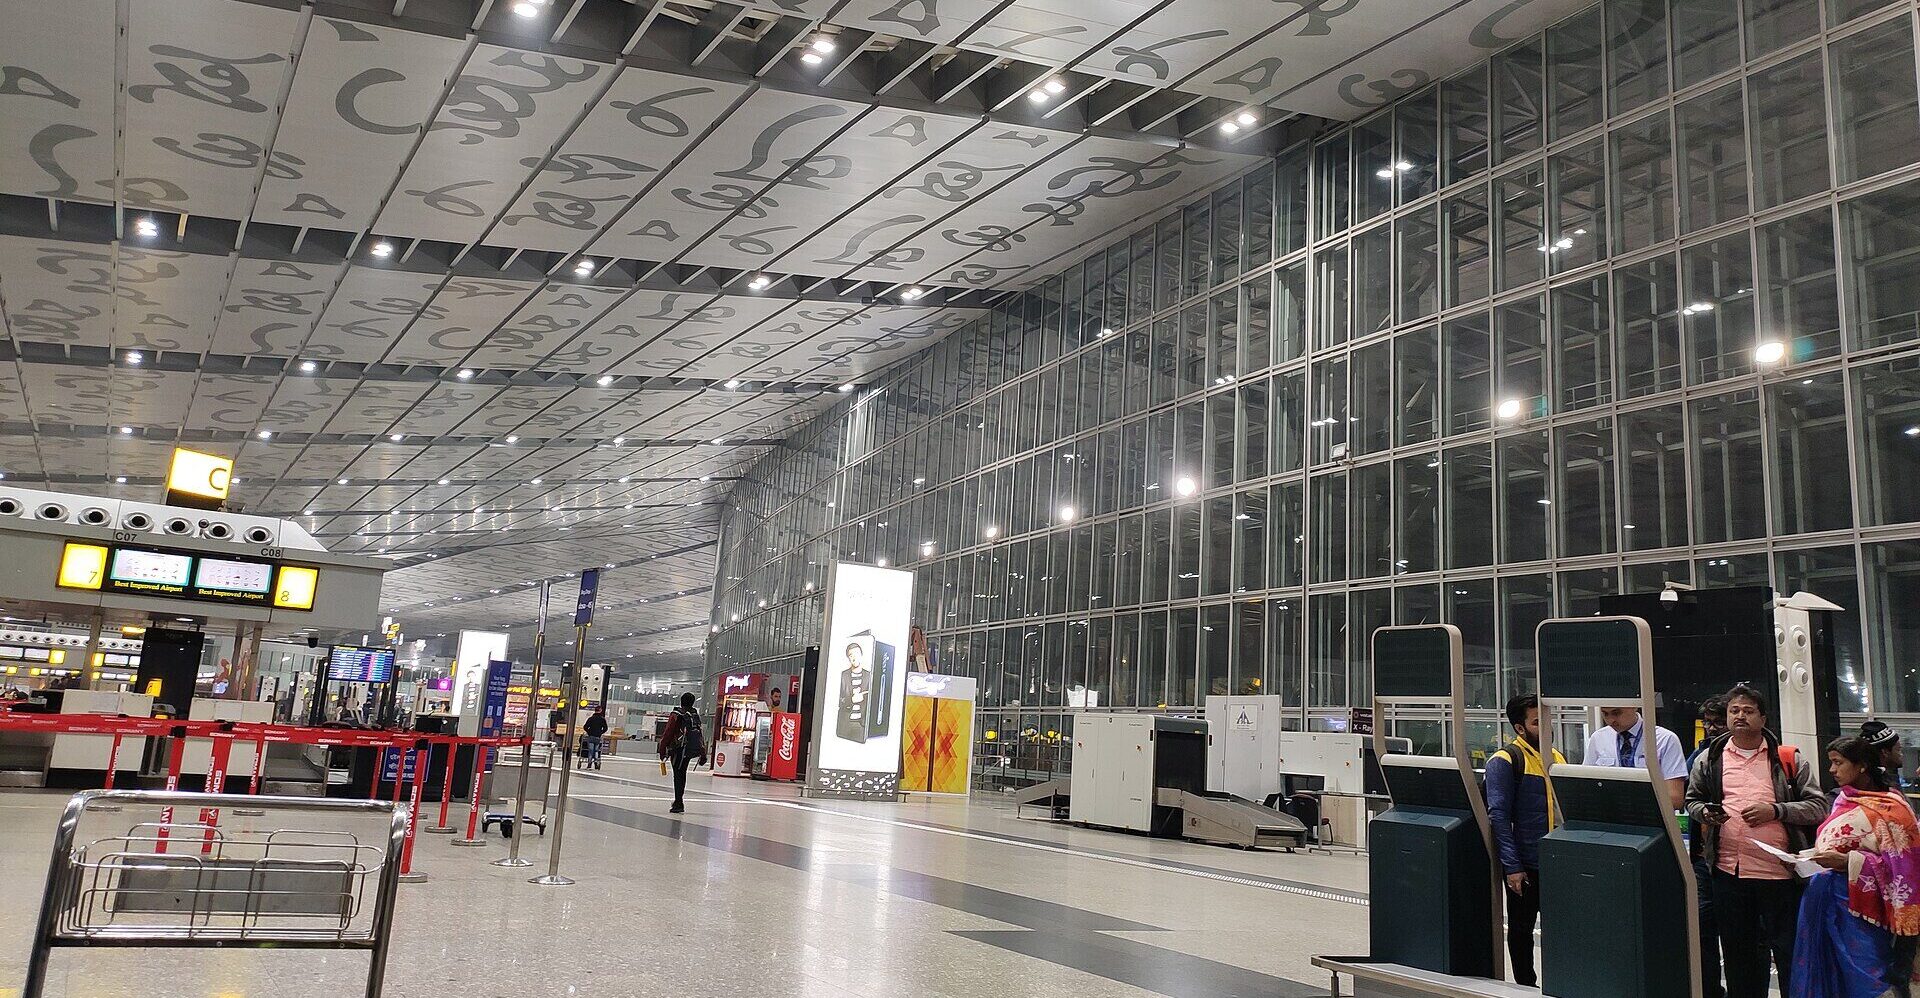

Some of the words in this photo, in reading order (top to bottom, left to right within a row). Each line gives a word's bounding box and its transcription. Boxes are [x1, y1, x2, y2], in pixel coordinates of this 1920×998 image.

[209, 468, 227, 490] C
[115, 531, 137, 541] C07
[260, 548, 281, 558] C08
[90, 571, 98, 583] 7
[281, 590, 290, 602] 8
